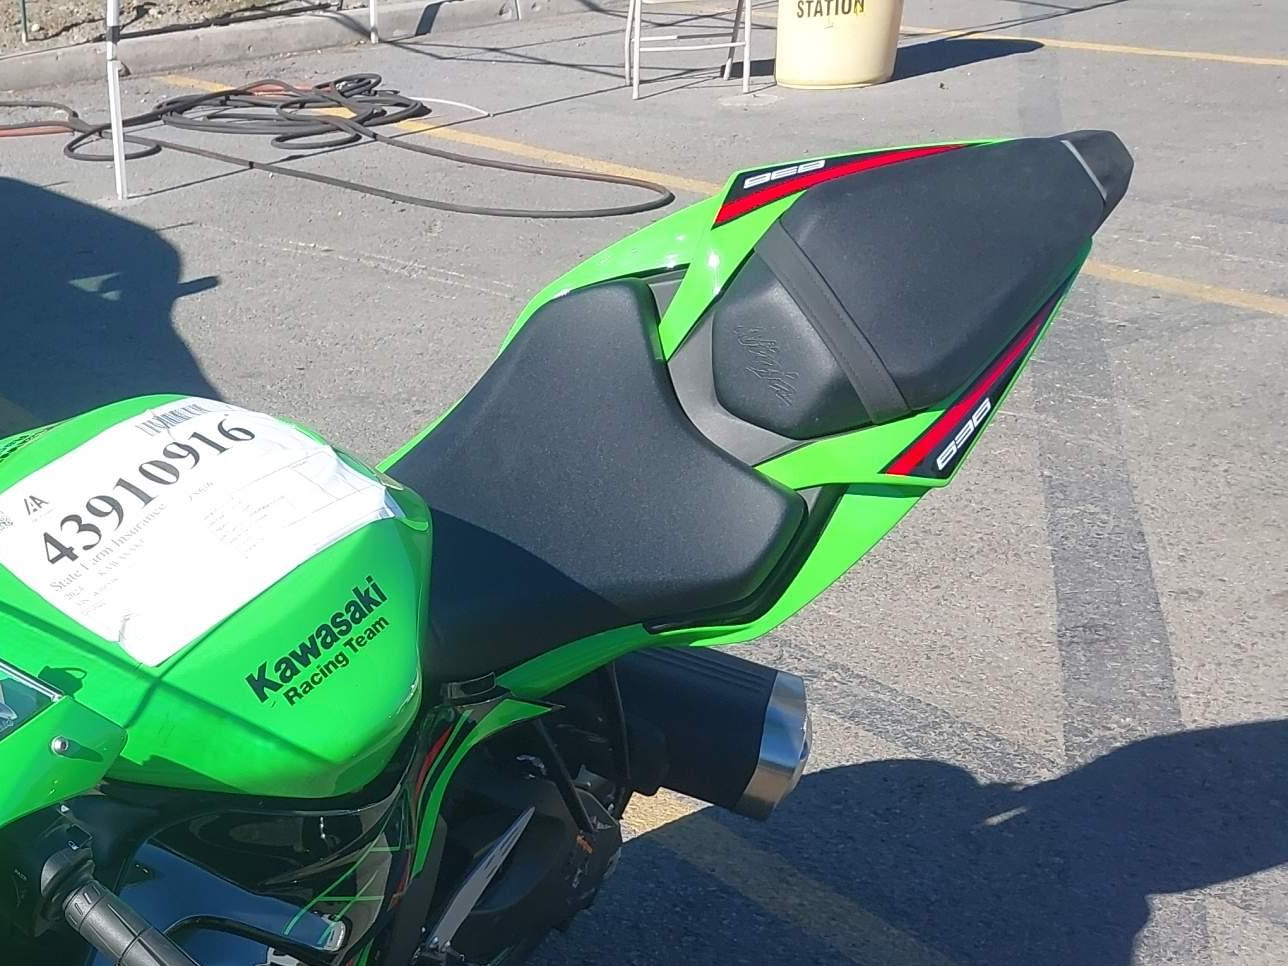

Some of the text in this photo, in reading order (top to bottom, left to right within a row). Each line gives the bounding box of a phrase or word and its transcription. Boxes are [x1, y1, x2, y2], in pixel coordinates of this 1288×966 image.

[796, 0, 865, 18] STATION
[936, 397, 991, 471] 636
[42, 417, 256, 565] 43910916
[50, 570, 83, 592] State
[111, 503, 167, 548] Insurance
[245, 575, 388, 703] Kawasaki
[283, 616, 389, 706] Racing Team
